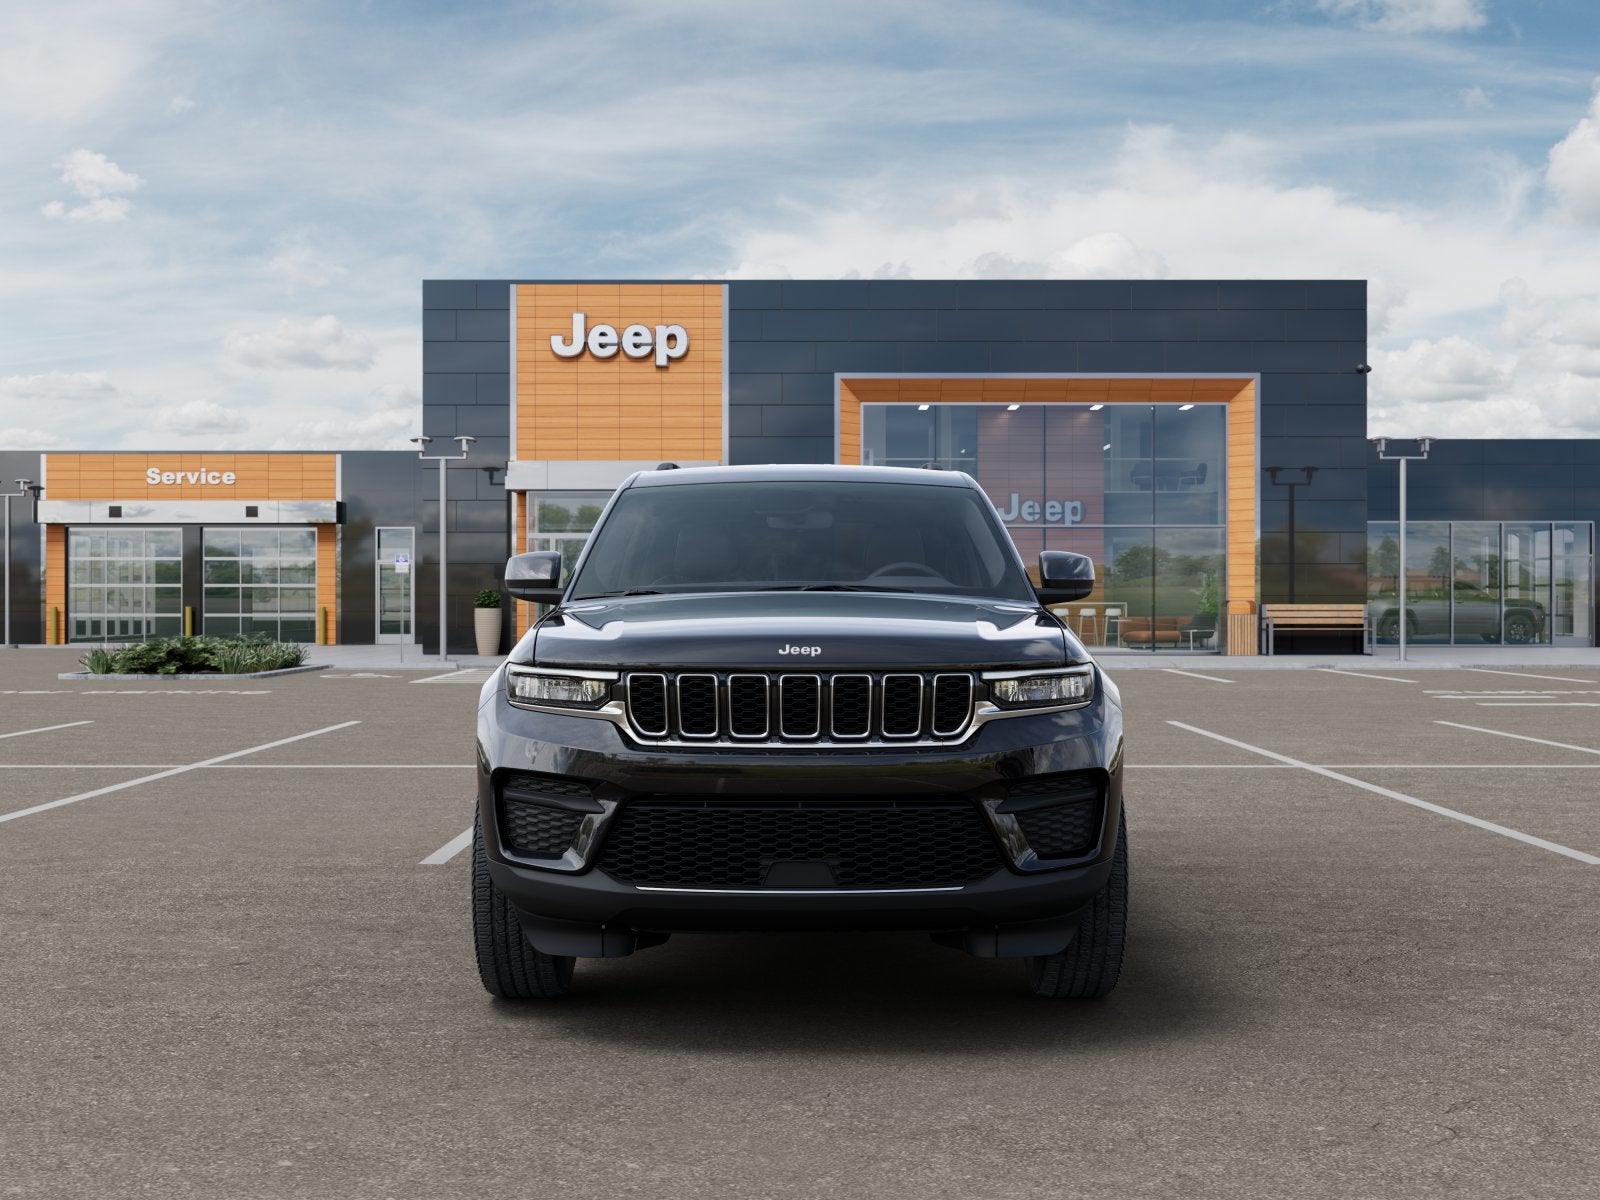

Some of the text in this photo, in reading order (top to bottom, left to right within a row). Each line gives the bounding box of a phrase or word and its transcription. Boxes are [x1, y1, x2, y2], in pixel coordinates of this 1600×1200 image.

[550, 312, 689, 367] Jeep
[146, 467, 237, 485] Service
[997, 493, 1085, 526] Jeep
[778, 644, 822, 657] Jeep
